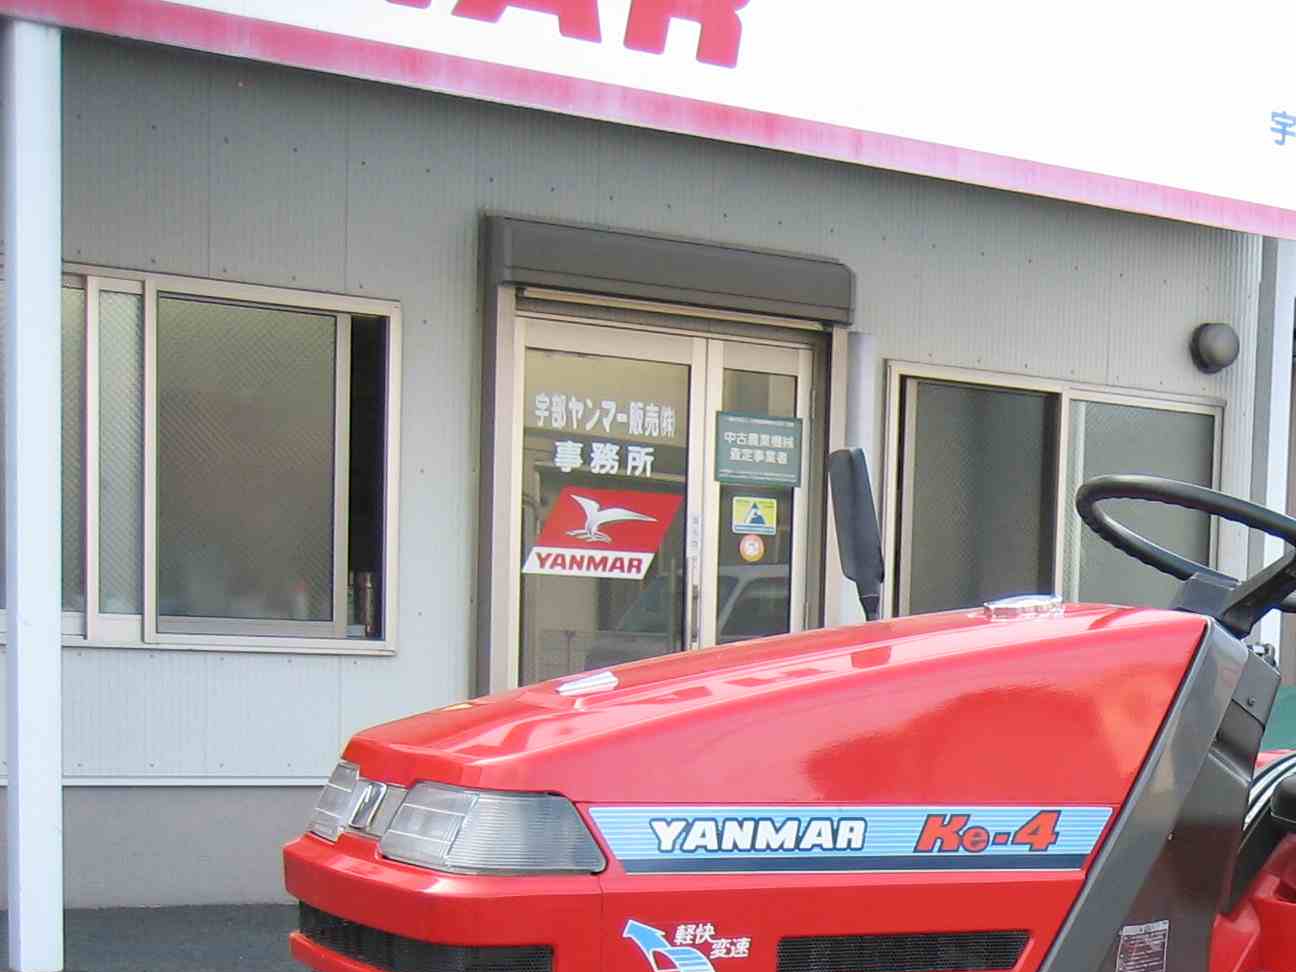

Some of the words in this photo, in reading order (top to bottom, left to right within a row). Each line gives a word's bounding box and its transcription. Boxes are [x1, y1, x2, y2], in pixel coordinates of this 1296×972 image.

[554, 439, 656, 477] 事務所
[534, 551, 643, 574] YANMAR
[649, 817, 868, 853] YANMAR
[912, 809, 1063, 853] Ke-4
[673, 922, 716, 946] 軽快
[709, 937, 752, 959] 変速
